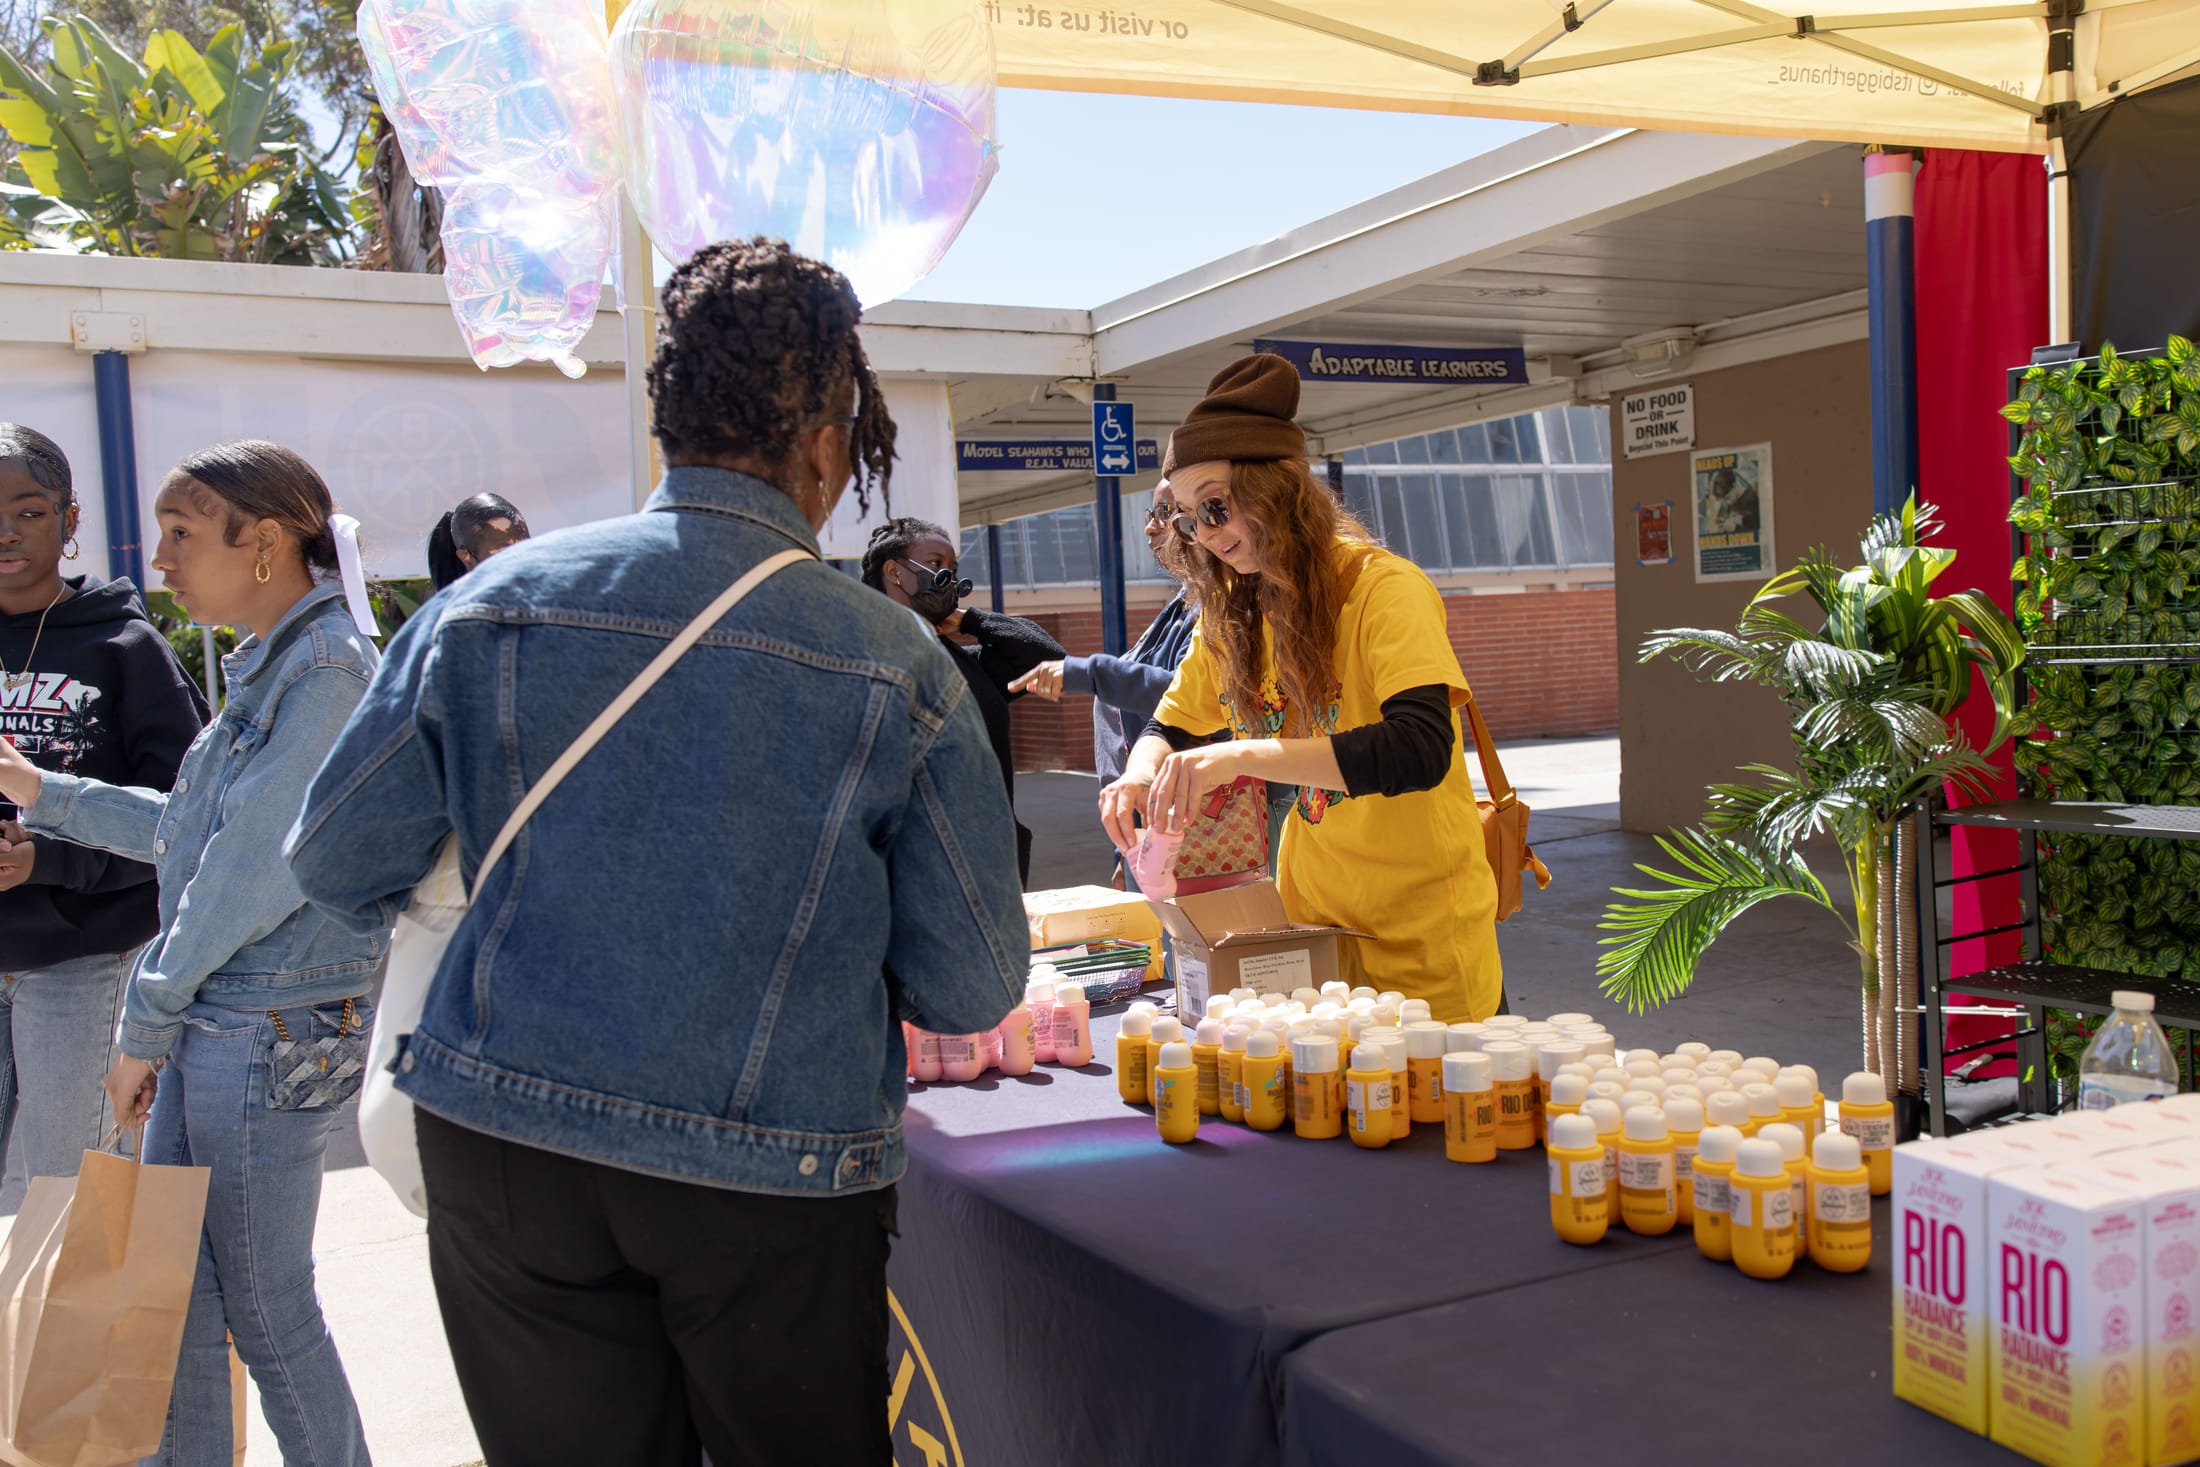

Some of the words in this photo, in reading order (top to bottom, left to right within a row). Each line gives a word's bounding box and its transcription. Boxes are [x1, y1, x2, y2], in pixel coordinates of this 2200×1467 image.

[1309, 348, 1417, 377] ADAPTABLE
[1421, 359, 1508, 378] LEARNERS
[1627, 399, 1645, 414] NO
[1650, 391, 1687, 409] FOOD
[1649, 410, 1664, 421] OR
[1636, 420, 1679, 440] DRINK
[963, 443, 1003, 458] MODEL
[1008, 445, 1063, 457] SEAHAWKS
[1067, 445, 1090, 457] WHO
[1138, 445, 1156, 456] OUR
[0, 715, 55, 733] NALS
[1502, 1095, 1520, 1114] RIO
[1904, 1208, 1966, 1306] RIO
[2001, 1242, 2070, 1347] RIO
